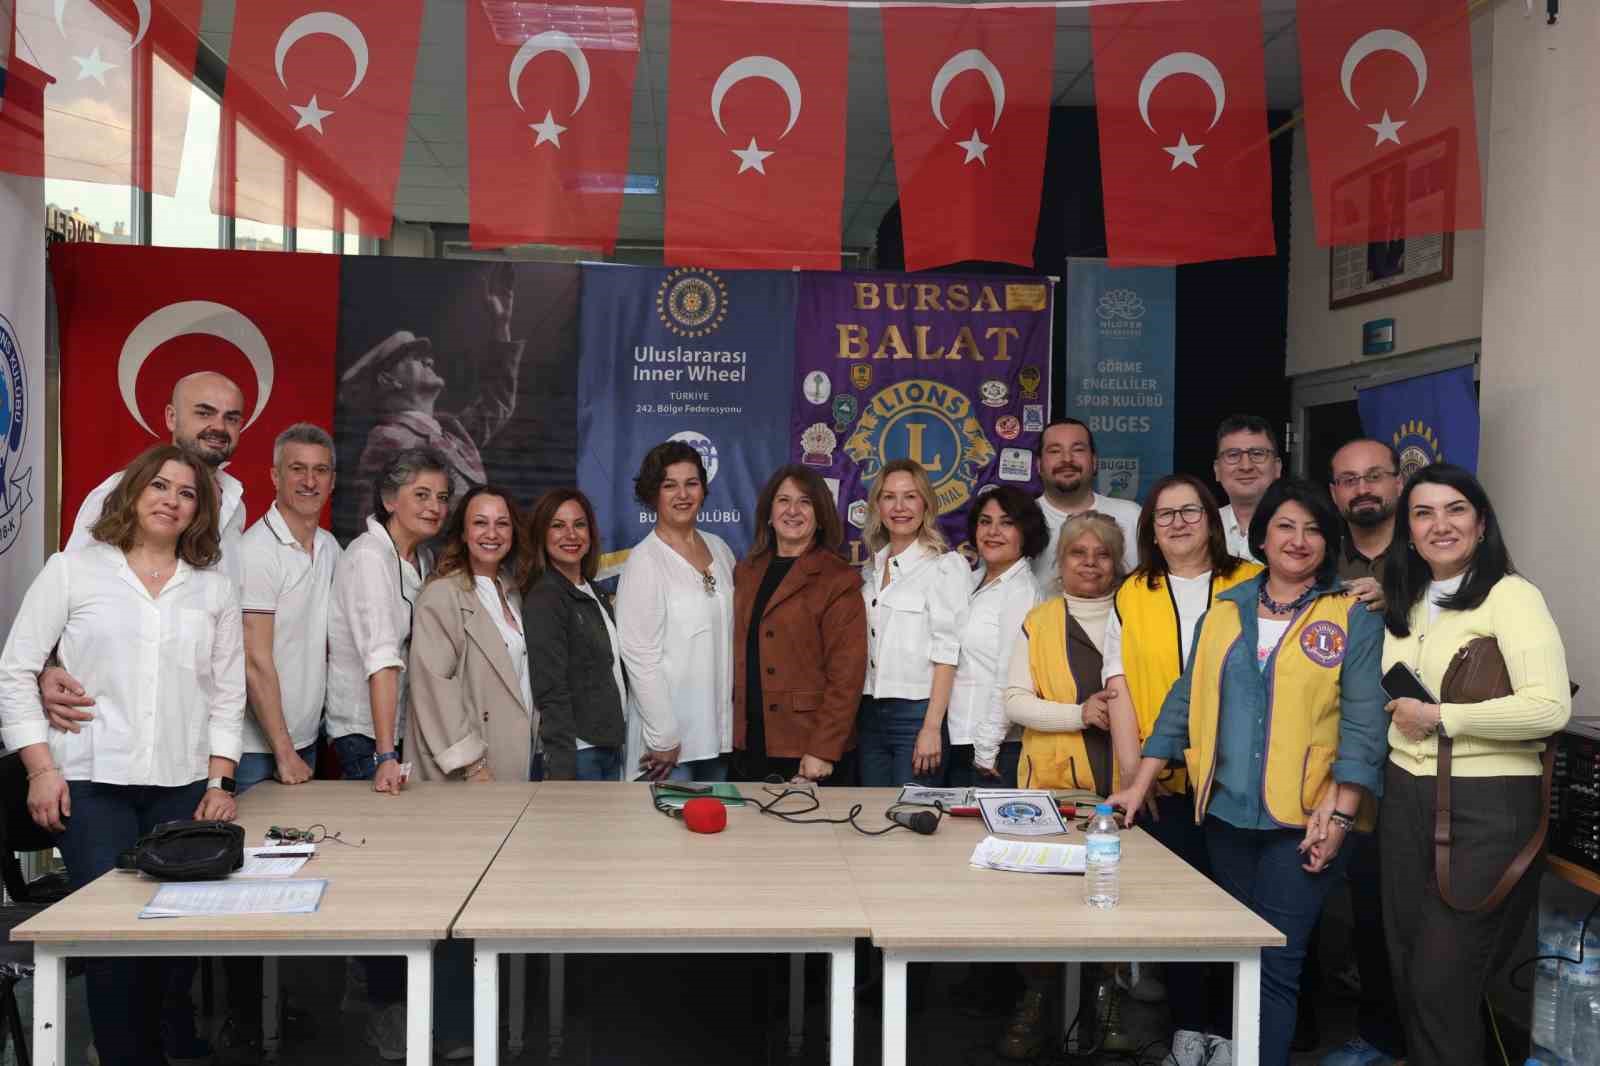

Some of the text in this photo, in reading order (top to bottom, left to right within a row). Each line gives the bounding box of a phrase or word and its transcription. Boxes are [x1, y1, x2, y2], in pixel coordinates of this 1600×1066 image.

[854, 282, 1003, 312] BURSA
[835, 324, 1020, 361] BALAT
[634, 346, 747, 363] Uluslararası
[633, 365, 746, 382] Inner Wheel
[1097, 360, 1144, 373] GÖRME
[878, 382, 963, 414] LIONS
[657, 403, 683, 415] Bölge
[685, 404, 742, 415] Federasyonu
[1089, 415, 1151, 433] BUGES
[905, 423, 941, 472] L
[696, 509, 741, 522] ULÜBÜ
